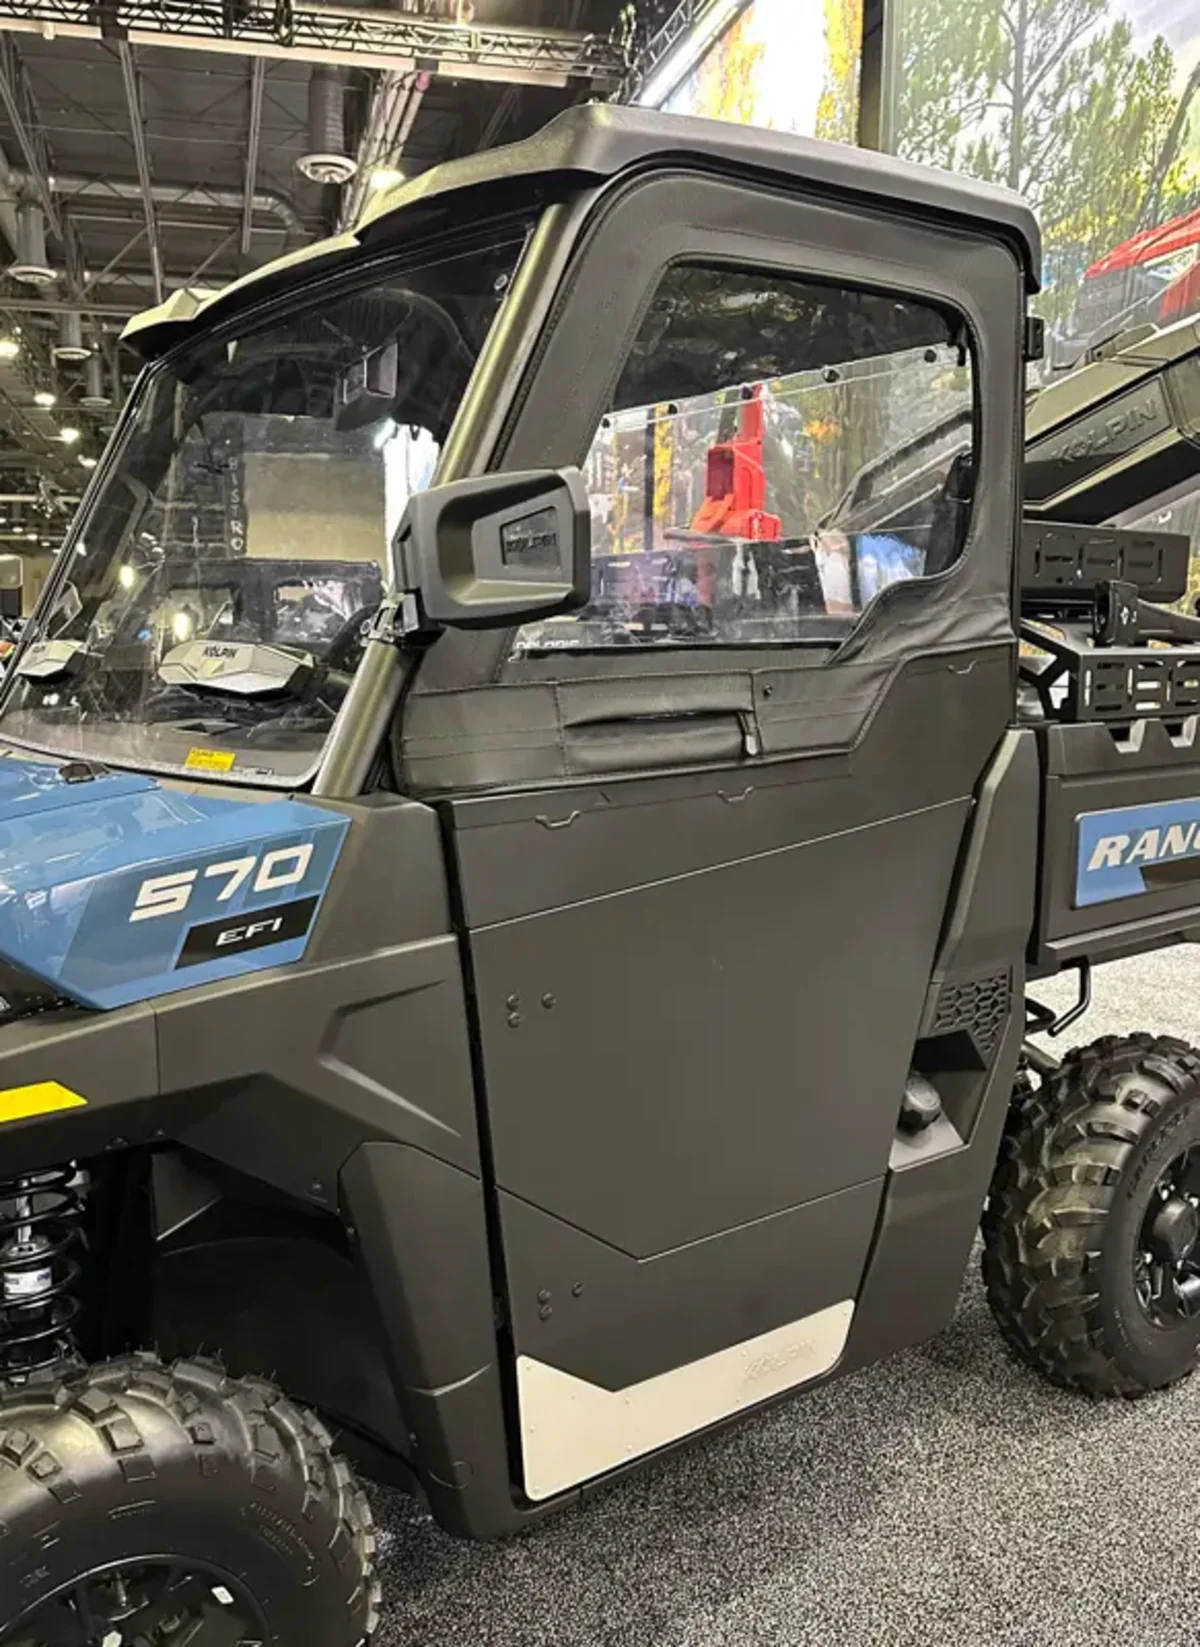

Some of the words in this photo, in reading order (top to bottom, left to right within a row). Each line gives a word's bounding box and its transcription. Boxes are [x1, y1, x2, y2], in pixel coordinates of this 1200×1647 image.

[1086, 822, 1200, 872] RAN
[129, 843, 314, 922] 570
[216, 917, 283, 946] EFI
